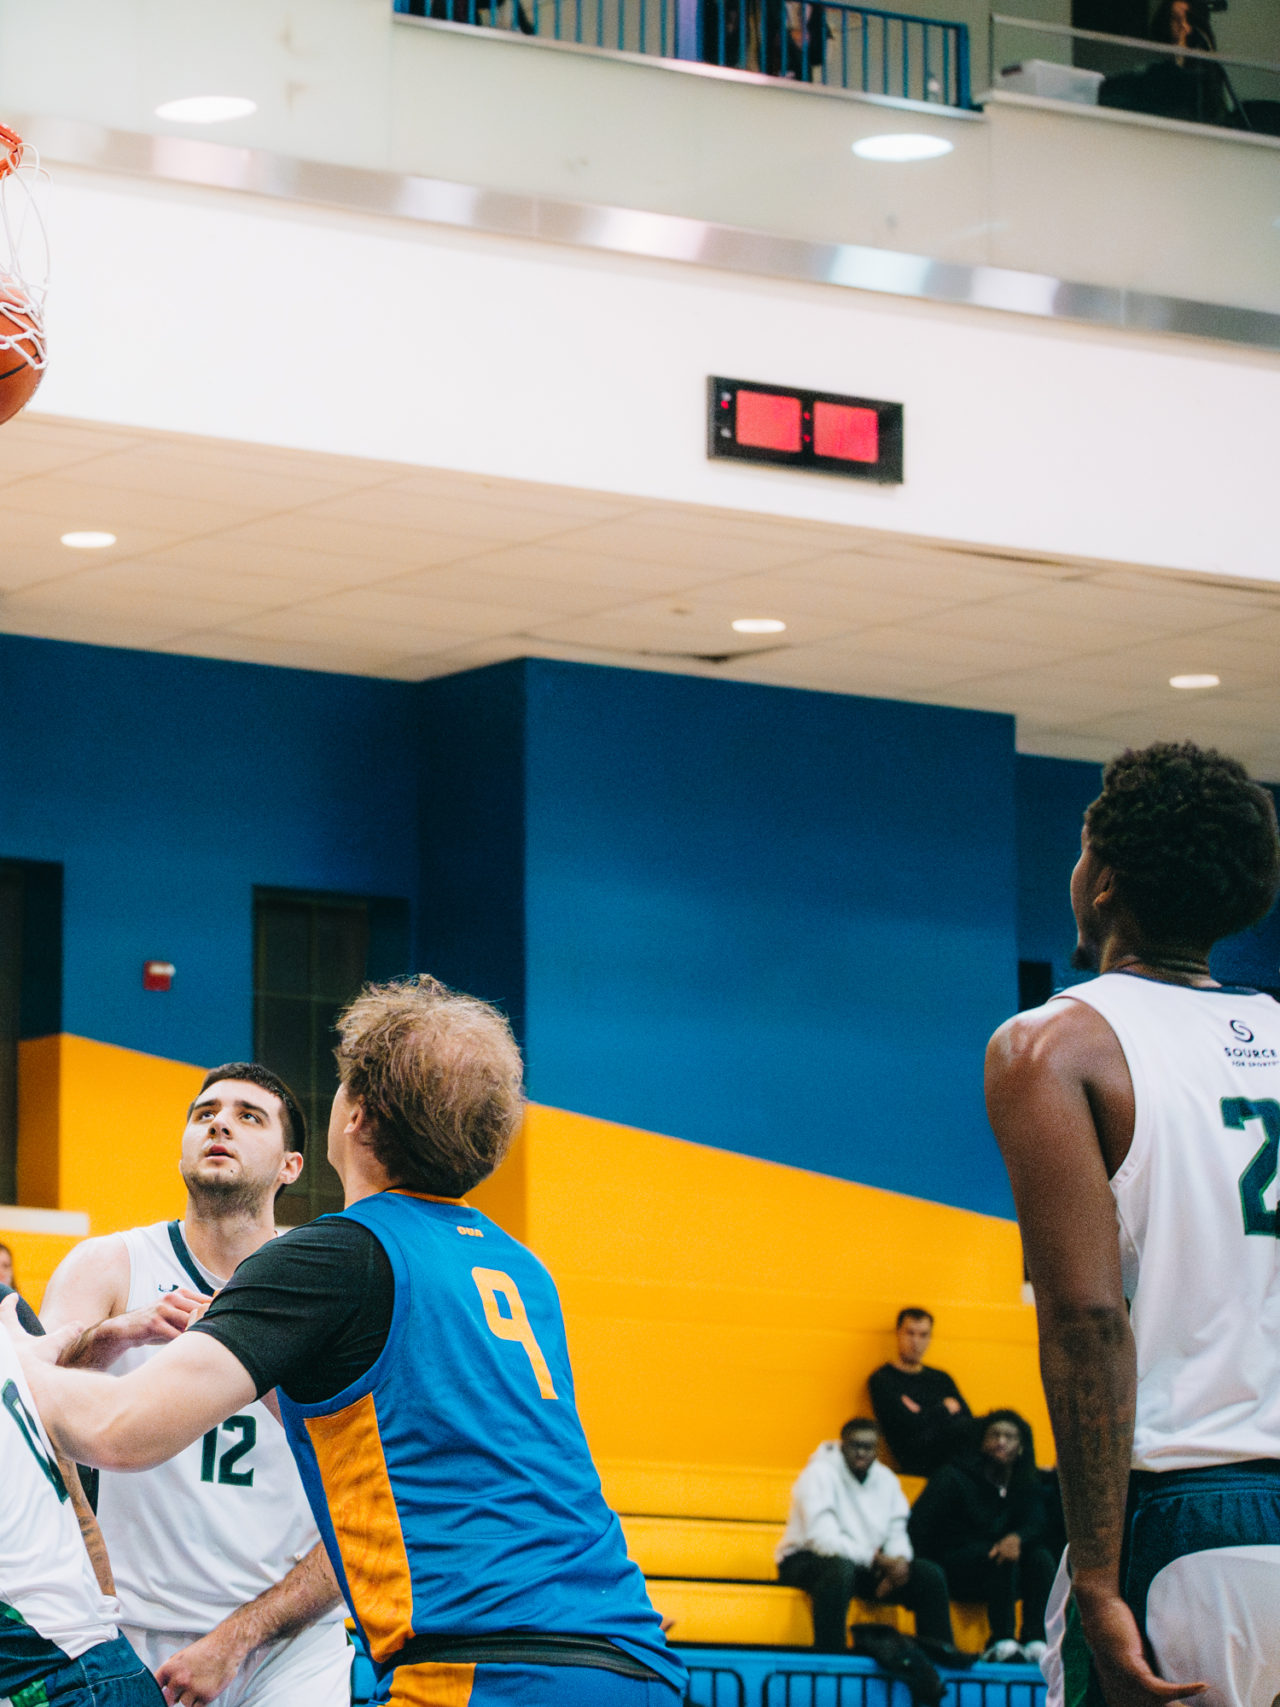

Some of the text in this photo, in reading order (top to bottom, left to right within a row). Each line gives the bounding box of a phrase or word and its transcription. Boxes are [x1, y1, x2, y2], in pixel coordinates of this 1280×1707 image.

[1224, 1047, 1277, 1059] SOURCE
[471, 1266, 559, 1400] 9
[200, 1414, 257, 1487] 12
